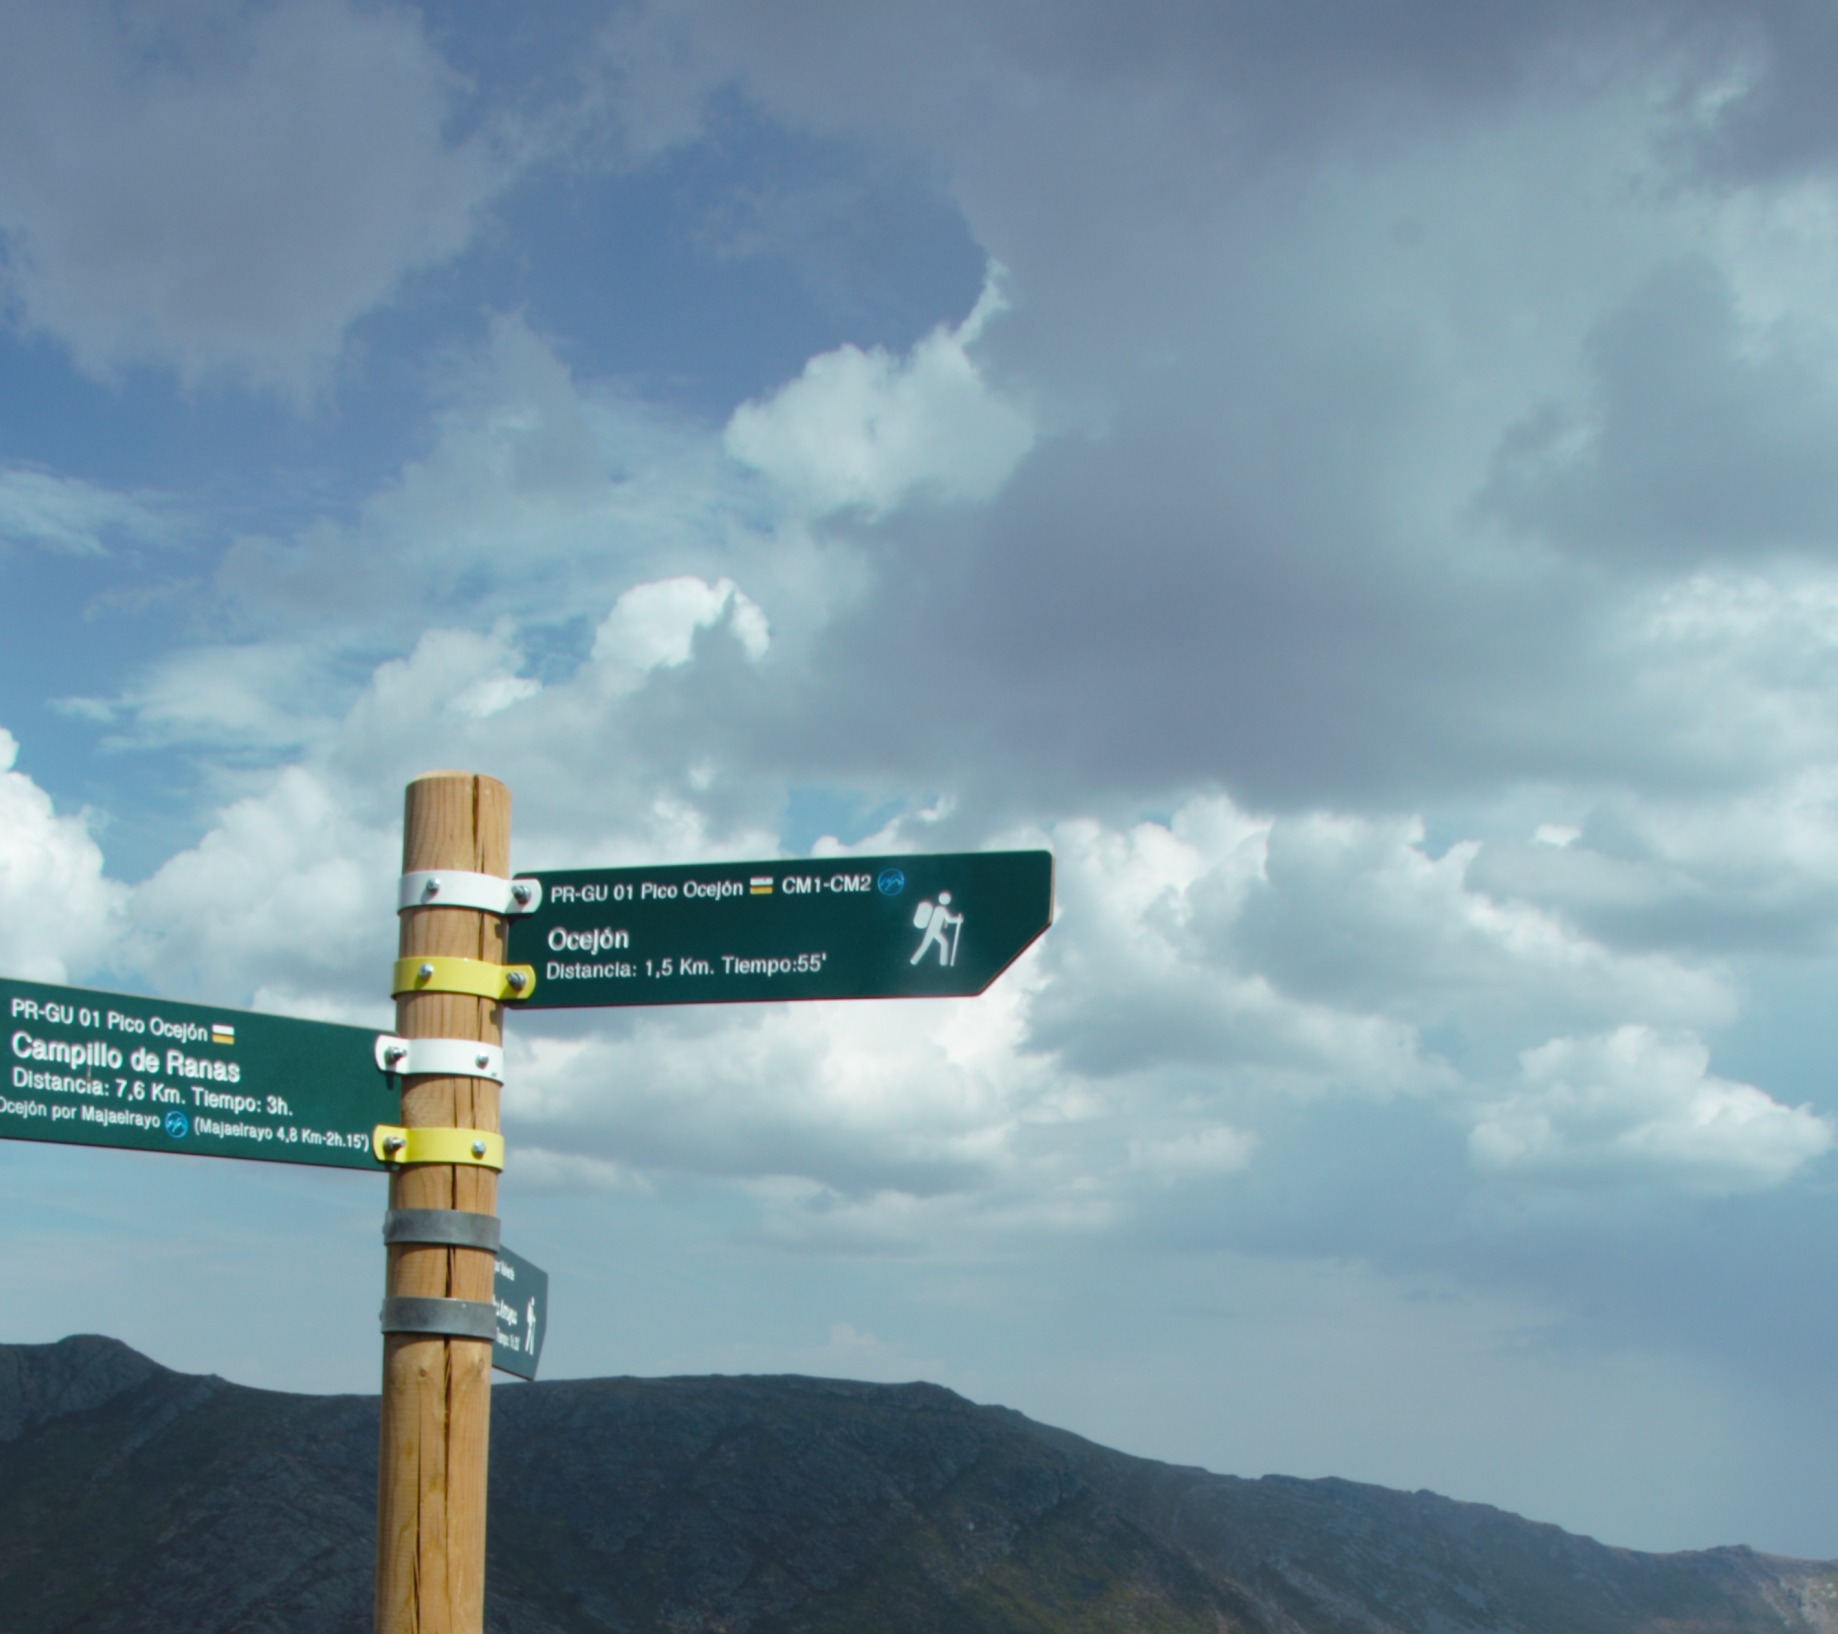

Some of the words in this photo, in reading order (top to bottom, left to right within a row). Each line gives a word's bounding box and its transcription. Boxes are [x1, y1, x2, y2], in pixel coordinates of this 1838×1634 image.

[551, 884, 608, 903] PR-GU
[613, 883, 633, 901] 01
[641, 882, 678, 900] Pico
[683, 879, 744, 901] Ocejón
[782, 873, 872, 895] CM1-CM2
[548, 926, 629, 956] Ocejón
[546, 961, 637, 980] Distancia:
[645, 958, 673, 979] 1,5
[679, 957, 715, 976] Km.
[12, 998, 74, 1025] PR-GU
[79, 1008, 100, 1028] 01
[107, 1010, 146, 1034] Pico
[149, 1016, 208, 1044] Ocejón
[12, 1030, 123, 1070] Campillo
[130, 1046, 160, 1073] de
[166, 1048, 241, 1083] Ranas
[13, 1066, 109, 1096] Distancia:
[115, 1078, 146, 1101] 7,6
[151, 1082, 186, 1105] Km.
[191, 1085, 262, 1115] Tiempo:
[266, 1094, 293, 1116] 3h.
[51, 1104, 77, 1121] por
[81, 1104, 161, 1130] Majaelrayo
